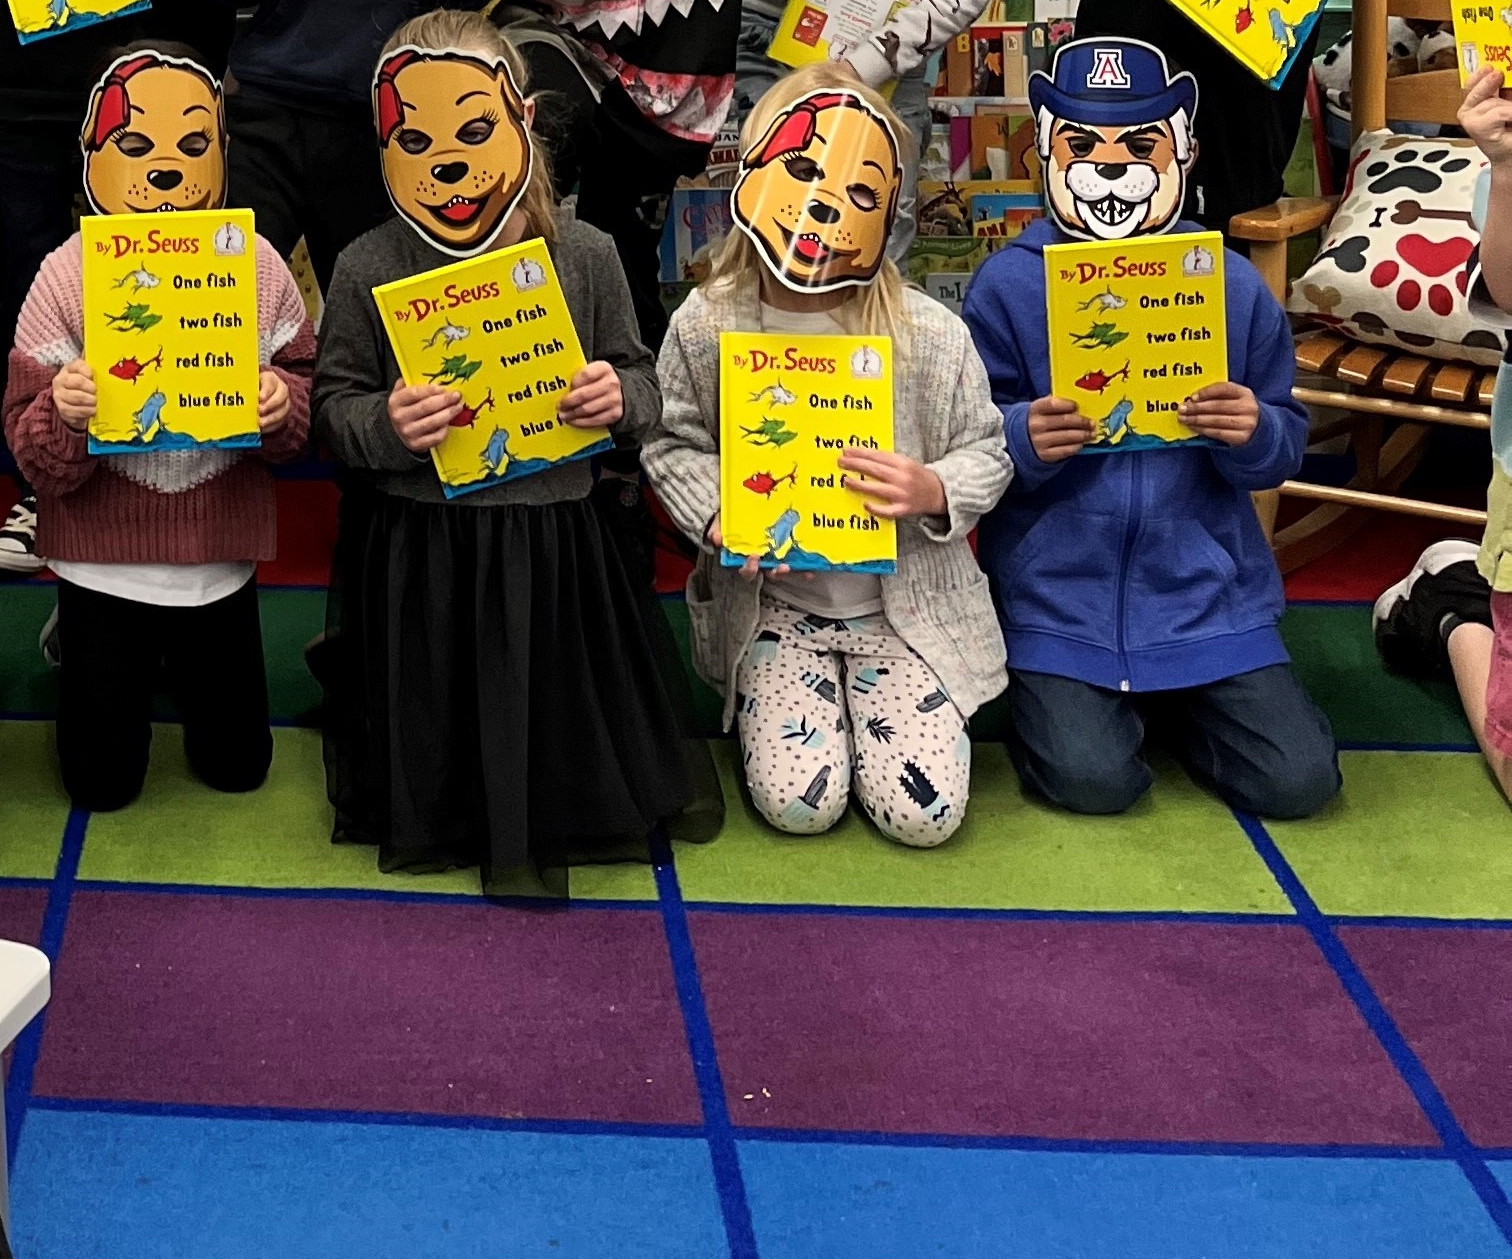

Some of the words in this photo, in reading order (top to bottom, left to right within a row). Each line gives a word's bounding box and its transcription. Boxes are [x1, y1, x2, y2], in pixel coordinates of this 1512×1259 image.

[1087, 48, 1131, 89] A
[1368, 208, 1385, 227] I
[1059, 269, 1077, 282] By
[1076, 262, 1110, 285] Dr.
[1112, 256, 1167, 278] Seuss
[1140, 295, 1169, 309] One
[1174, 291, 1205, 306] fish
[1146, 331, 1176, 344] two
[1181, 326, 1211, 341] fish
[1143, 364, 1168, 378] red
[1172, 361, 1203, 377] fish
[1146, 400, 1179, 413] blue
